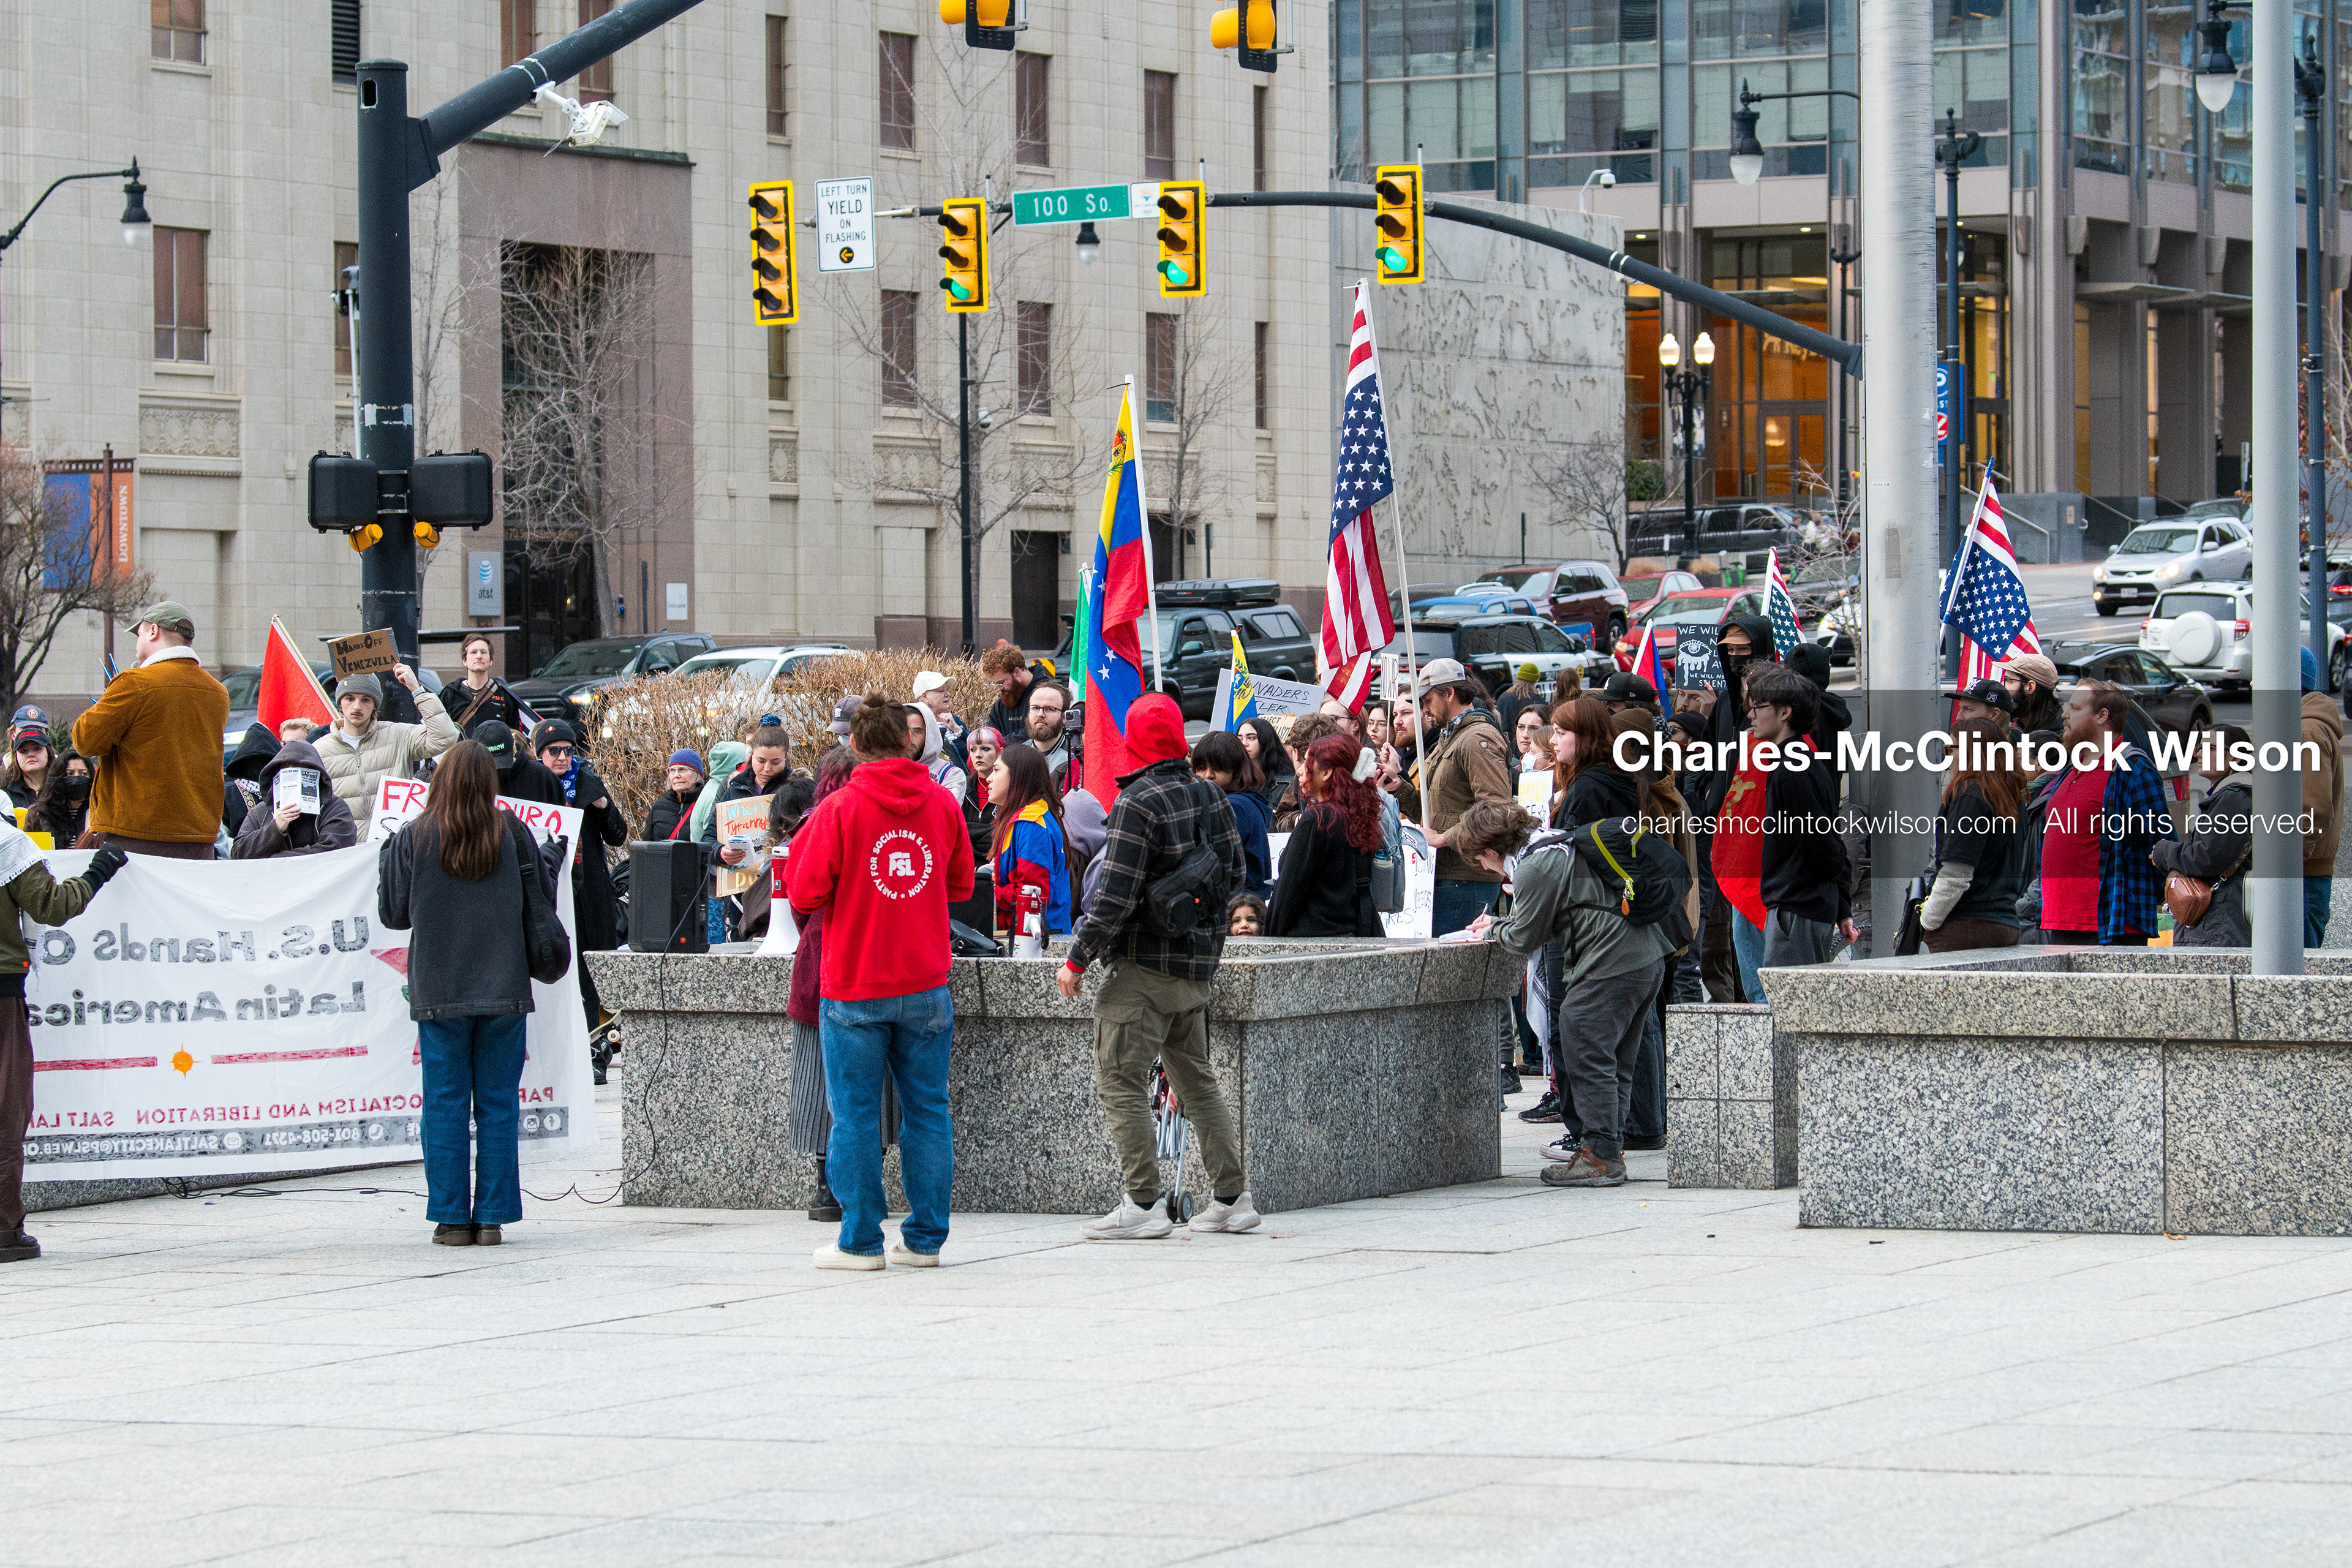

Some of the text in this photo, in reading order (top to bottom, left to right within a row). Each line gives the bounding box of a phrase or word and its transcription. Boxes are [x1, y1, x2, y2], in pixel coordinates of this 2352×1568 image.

[821, 184, 867, 197] LEFT TURN
[827, 199, 862, 214] YIELD
[1033, 195, 1068, 217] 100
[840, 219, 851, 228] ON
[826, 231, 866, 243] FLASHING
[119, 485, 127, 562] DOWNTOWN
[478, 588, 493, 599] at&t
[1678, 626, 1719, 635] WE WIL
[364, 635, 383, 649] OFF
[1253, 681, 1310, 700] VADERS
[382, 780, 427, 813] FR
[1520, 779, 1547, 805] HANDS
[727, 802, 769, 820] When
[870, 829, 933, 900] PARTY FOR SOCIALISM & LIBERATION
[889, 855, 915, 876] PSL
